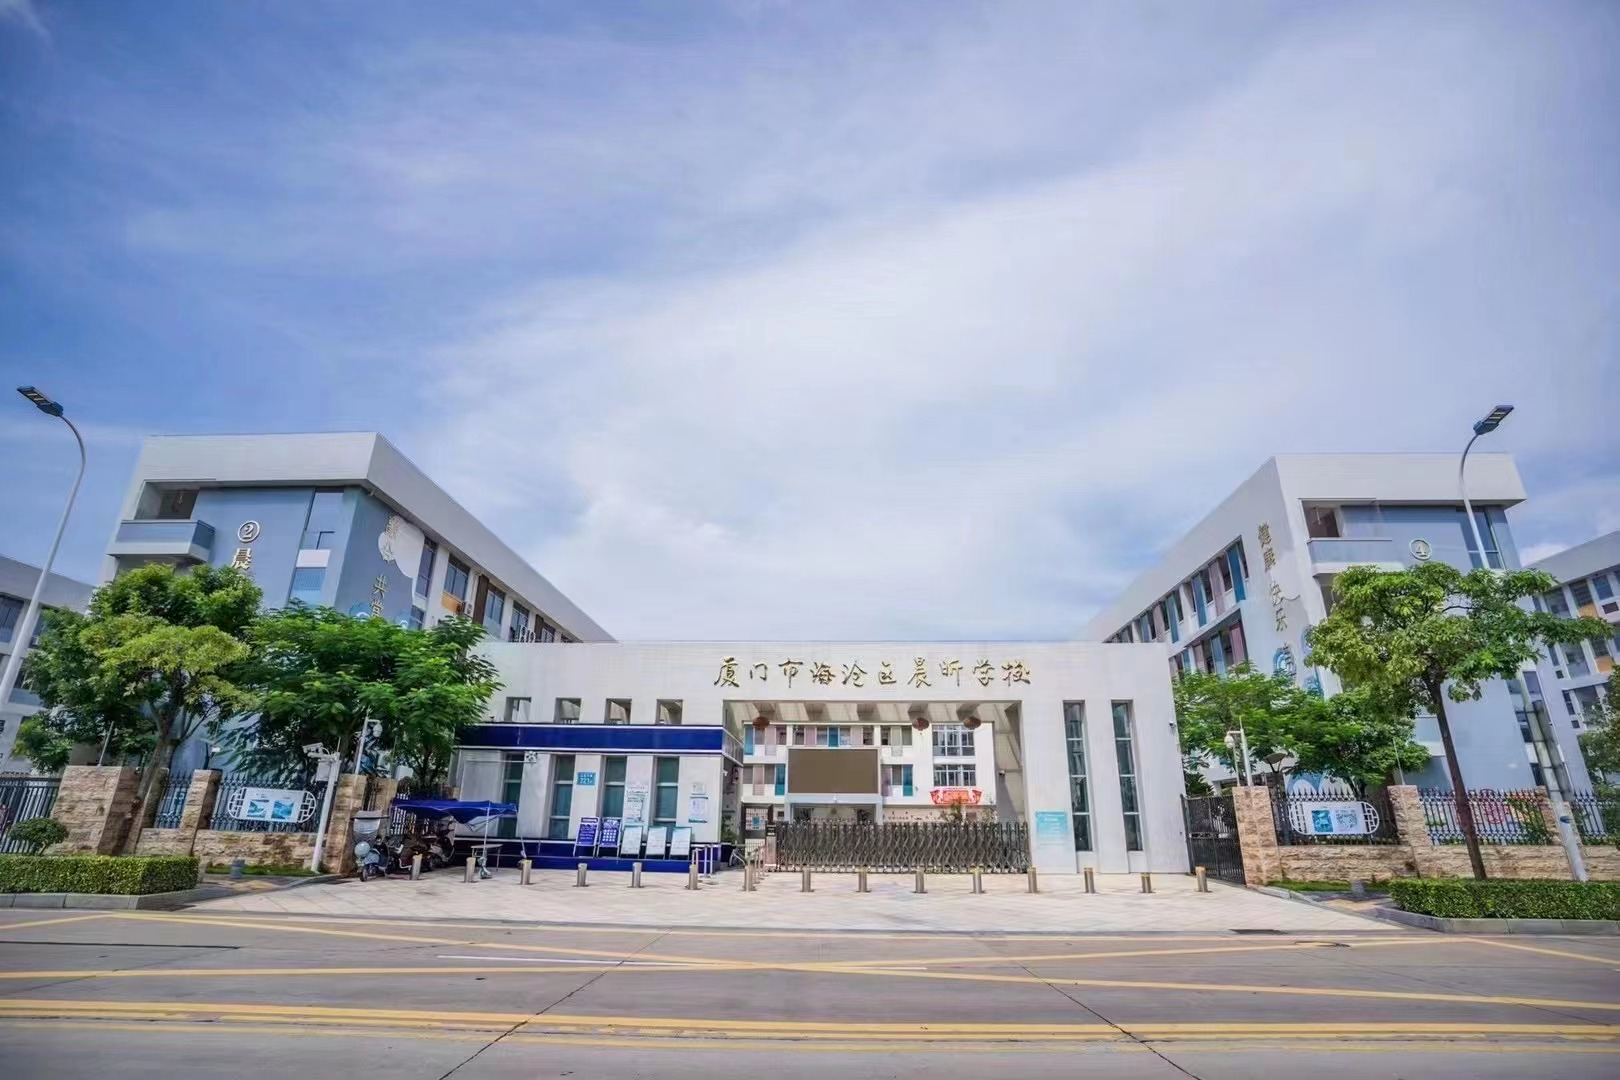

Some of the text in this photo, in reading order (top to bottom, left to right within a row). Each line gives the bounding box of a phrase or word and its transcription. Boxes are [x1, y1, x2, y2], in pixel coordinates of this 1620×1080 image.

[713, 656, 1031, 689] 厦门市海沧区晨昕学校
